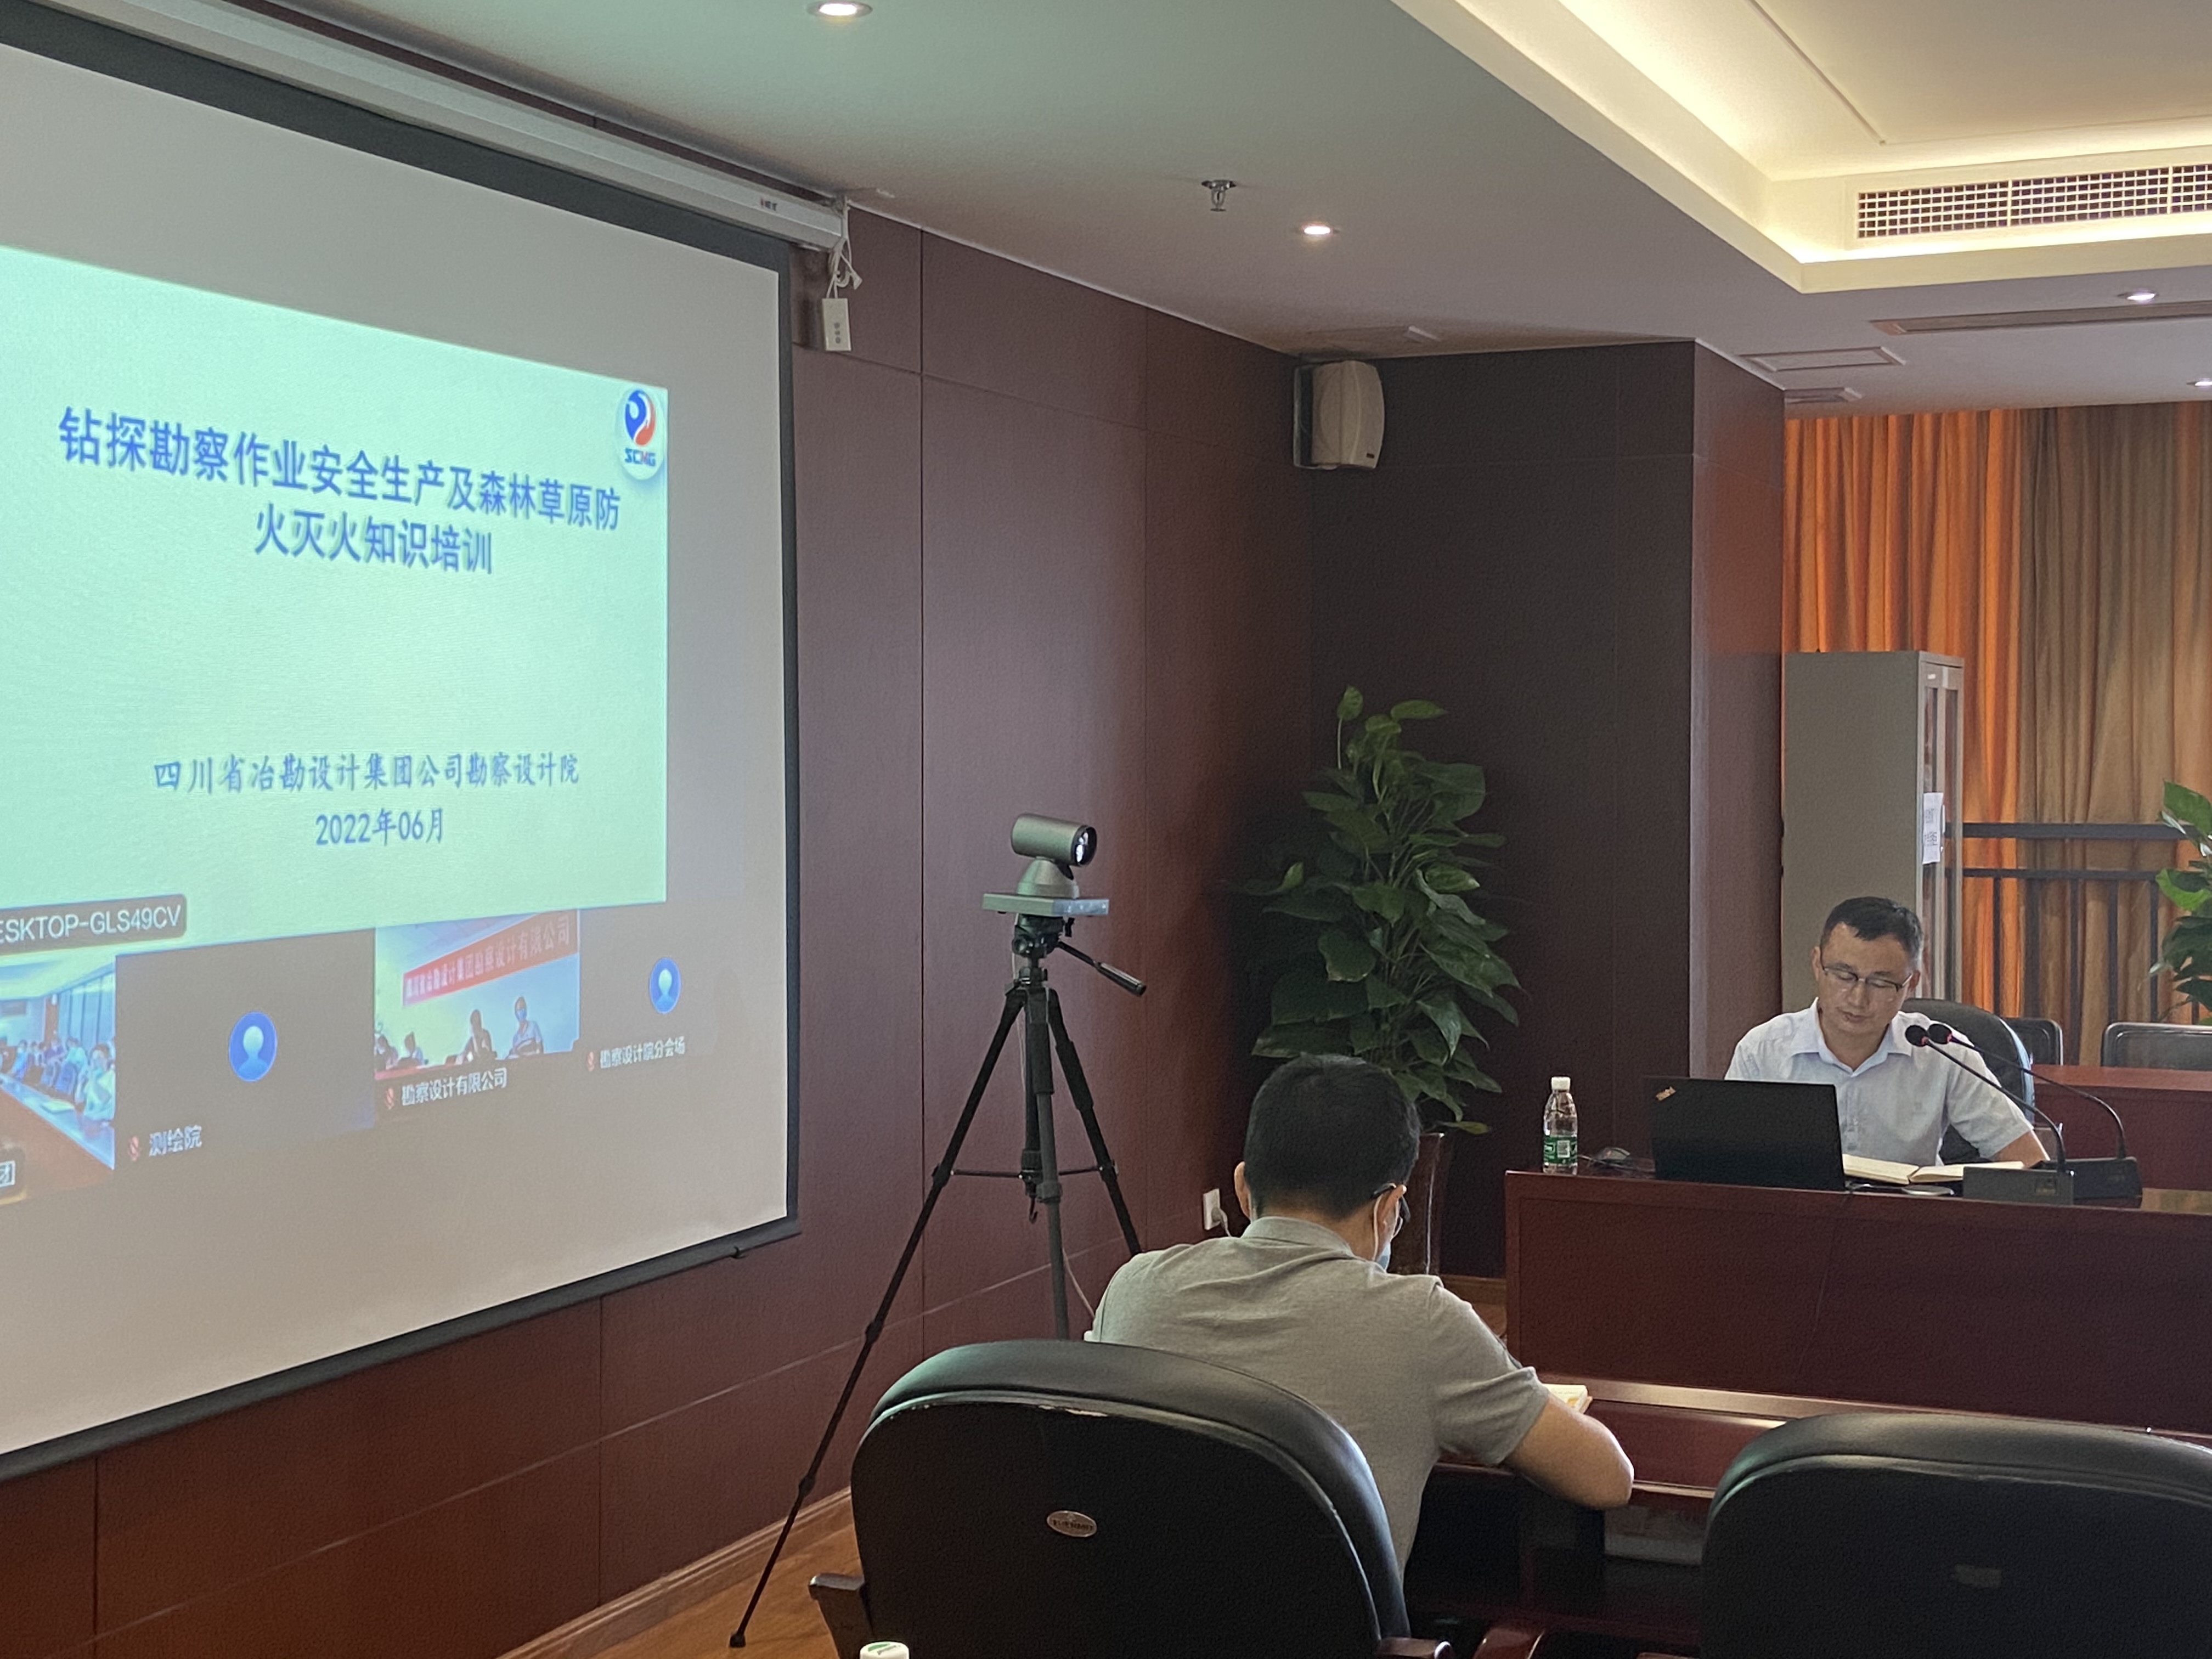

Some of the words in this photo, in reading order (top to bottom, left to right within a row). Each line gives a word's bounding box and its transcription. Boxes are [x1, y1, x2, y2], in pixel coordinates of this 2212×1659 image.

[59, 406, 620, 531] 钻探勘察作业安全生产及森林草原防
[254, 503, 492, 574] 火灭火知识培训
[154, 751, 579, 794] 四川省冶勘设计集团公司勘察设计院
[315, 807, 443, 845] 2022年06月
[402, 1068, 507, 1106] 勘察设计有限公司
[149, 1125, 202, 1156] 测绘院
